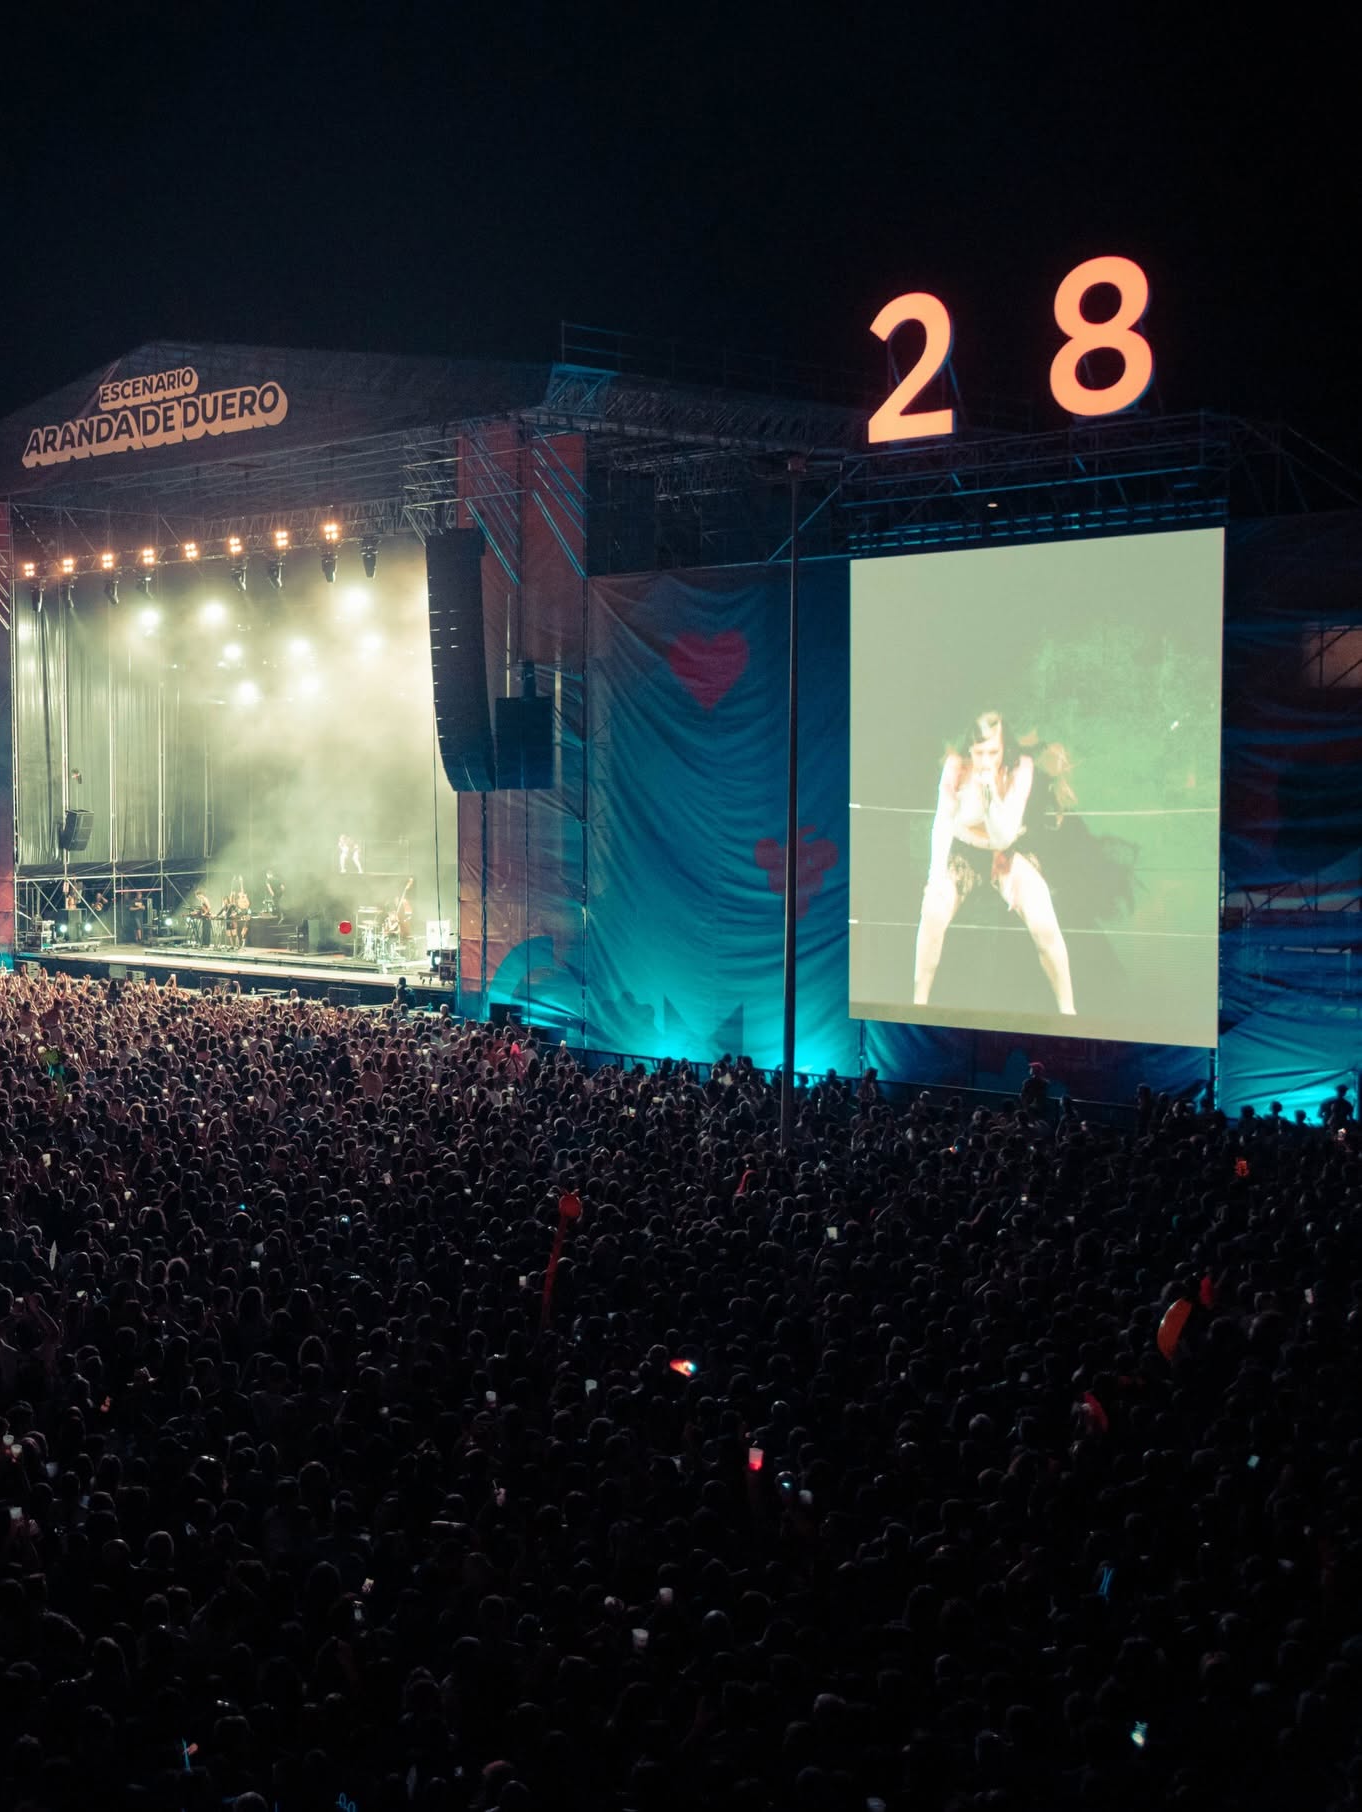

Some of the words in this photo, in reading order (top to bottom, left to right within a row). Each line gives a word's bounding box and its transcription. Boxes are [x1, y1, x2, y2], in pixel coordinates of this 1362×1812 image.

[100, 366, 194, 404] ESCENARIO
[25, 413, 135, 457] ARANDA
[142, 404, 175, 436] DE
[182, 384, 280, 429] DUERO
